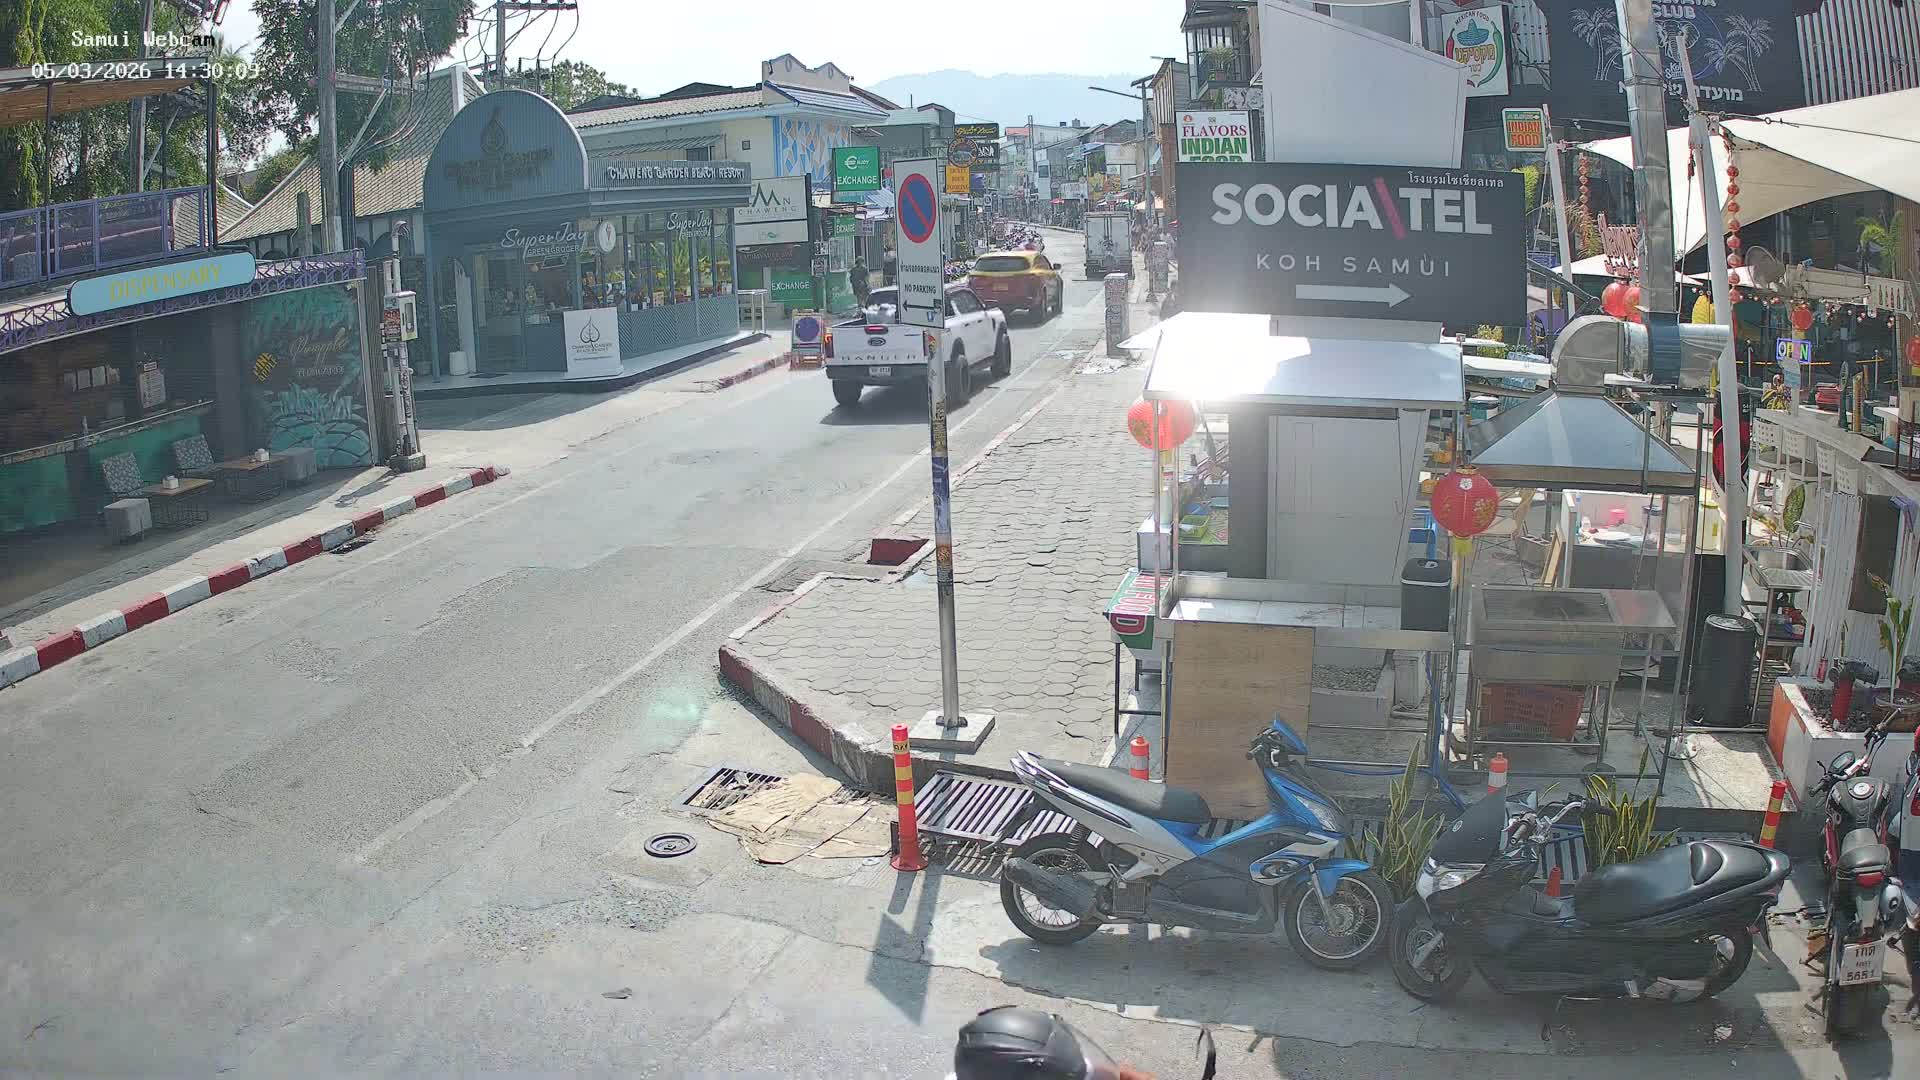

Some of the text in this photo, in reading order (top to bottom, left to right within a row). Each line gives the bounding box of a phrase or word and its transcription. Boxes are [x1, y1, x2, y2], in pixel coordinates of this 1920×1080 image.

[1455, 11, 1476, 25] MEXICAN
[1651, 5, 1696, 19] CLUB
[1182, 125, 1247, 137] FLAVORS
[1508, 121, 1541, 133] INDIAN
[1511, 134, 1541, 146] FOOD
[1181, 138, 1248, 155] INDIAN
[607, 165, 745, 179] CHAWENG GARDEN BEACH RESORT
[837, 175, 878, 185] EXCHANGE
[836, 223, 856, 234] EXCHANGE
[1256, 253, 1450, 278] KOH SAMUI
[109, 264, 223, 303] DISPENSARY
[771, 281, 810, 290] EXCHANGE
[904, 284, 937, 295] NO PARKING
